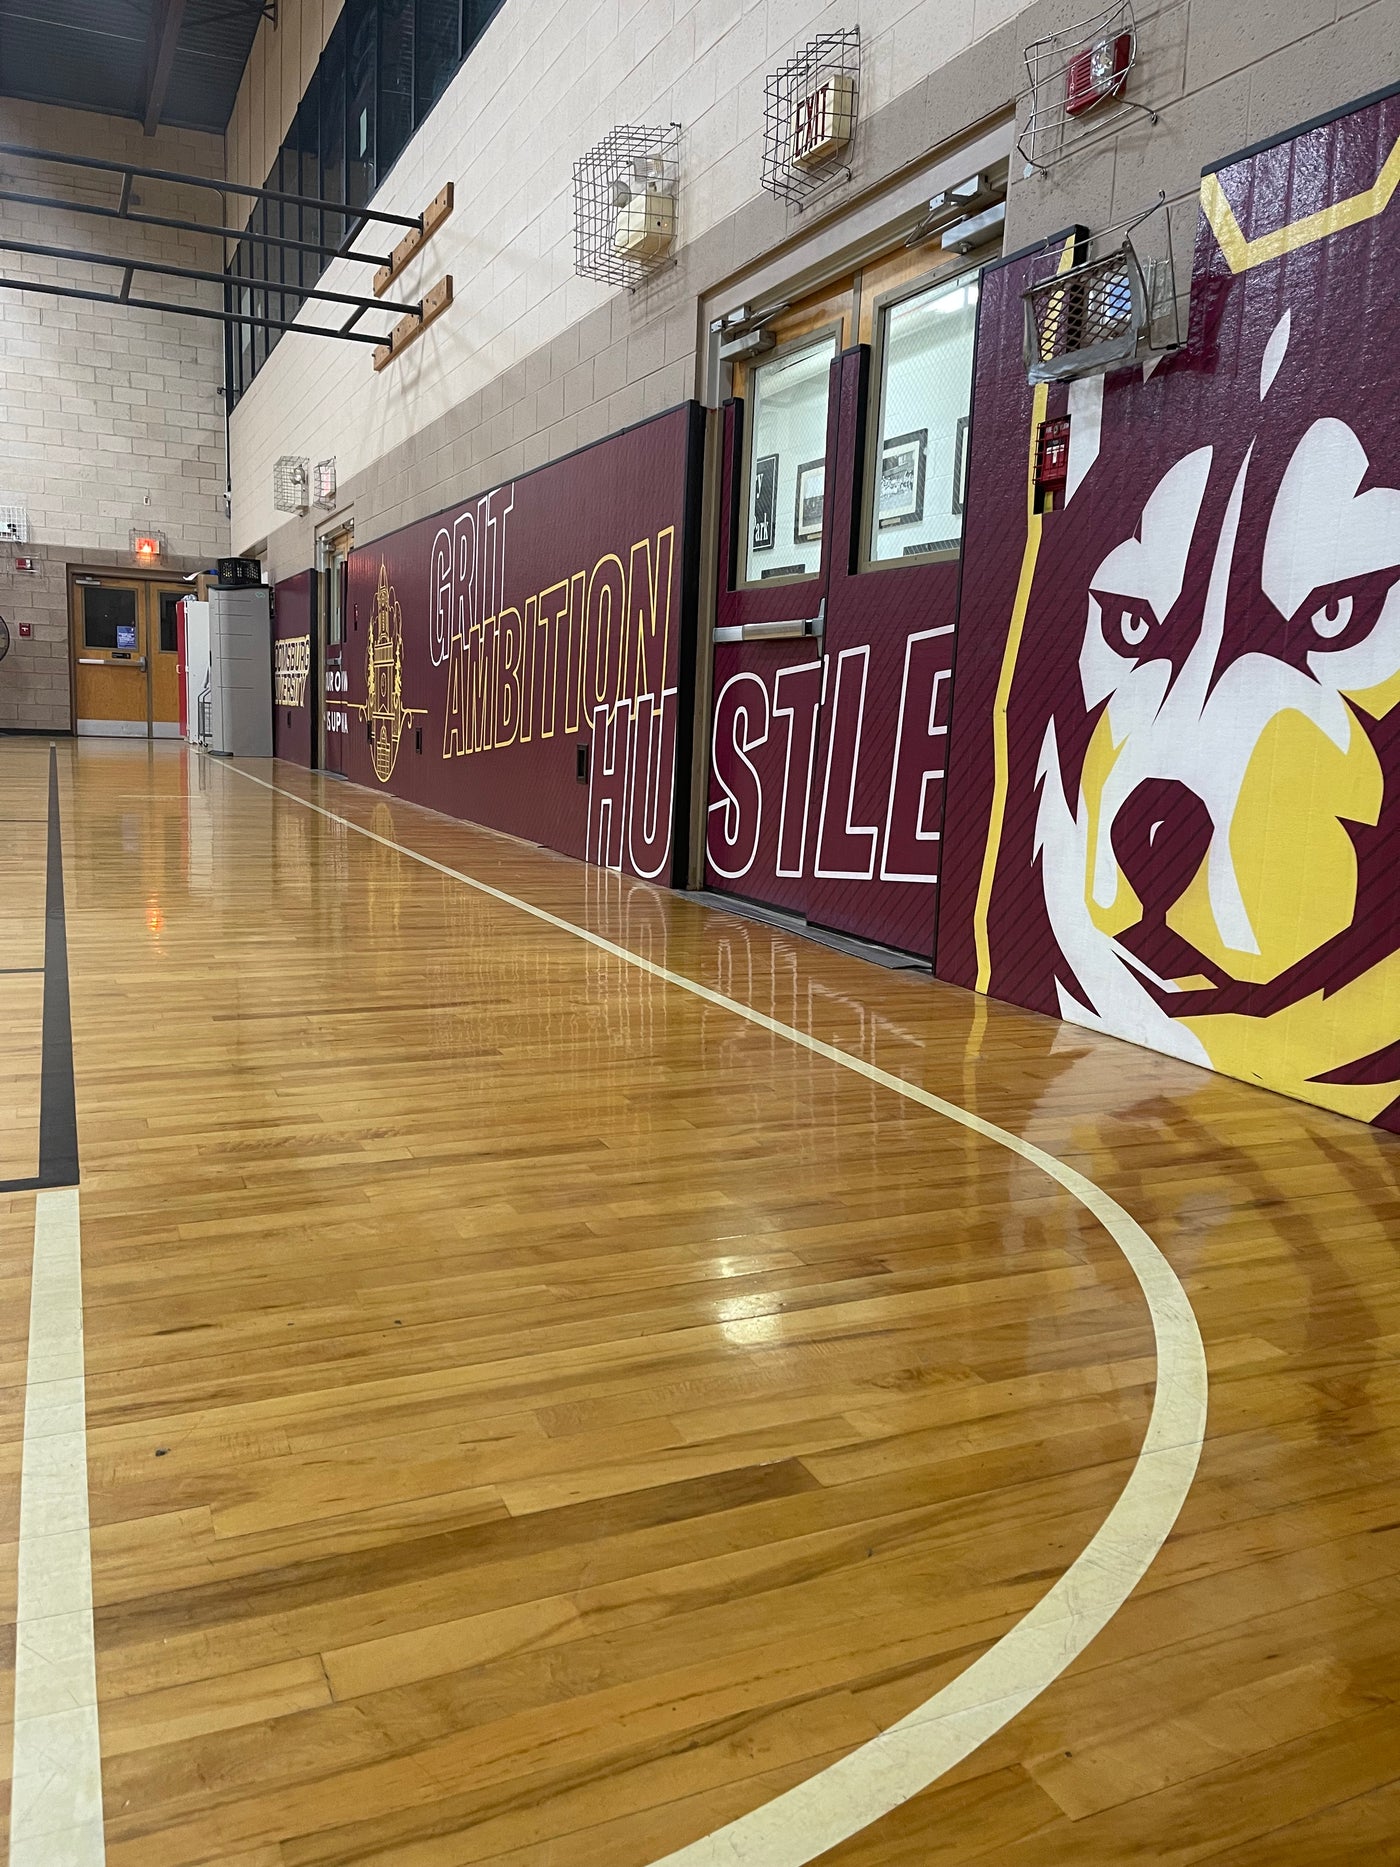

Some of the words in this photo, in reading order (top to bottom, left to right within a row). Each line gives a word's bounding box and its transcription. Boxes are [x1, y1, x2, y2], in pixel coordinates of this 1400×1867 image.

[795, 82, 829, 158] EXIT
[429, 482, 514, 667] GRIT
[442, 525, 674, 759] AMBITION
[585, 623, 955, 884] HUSTLE
